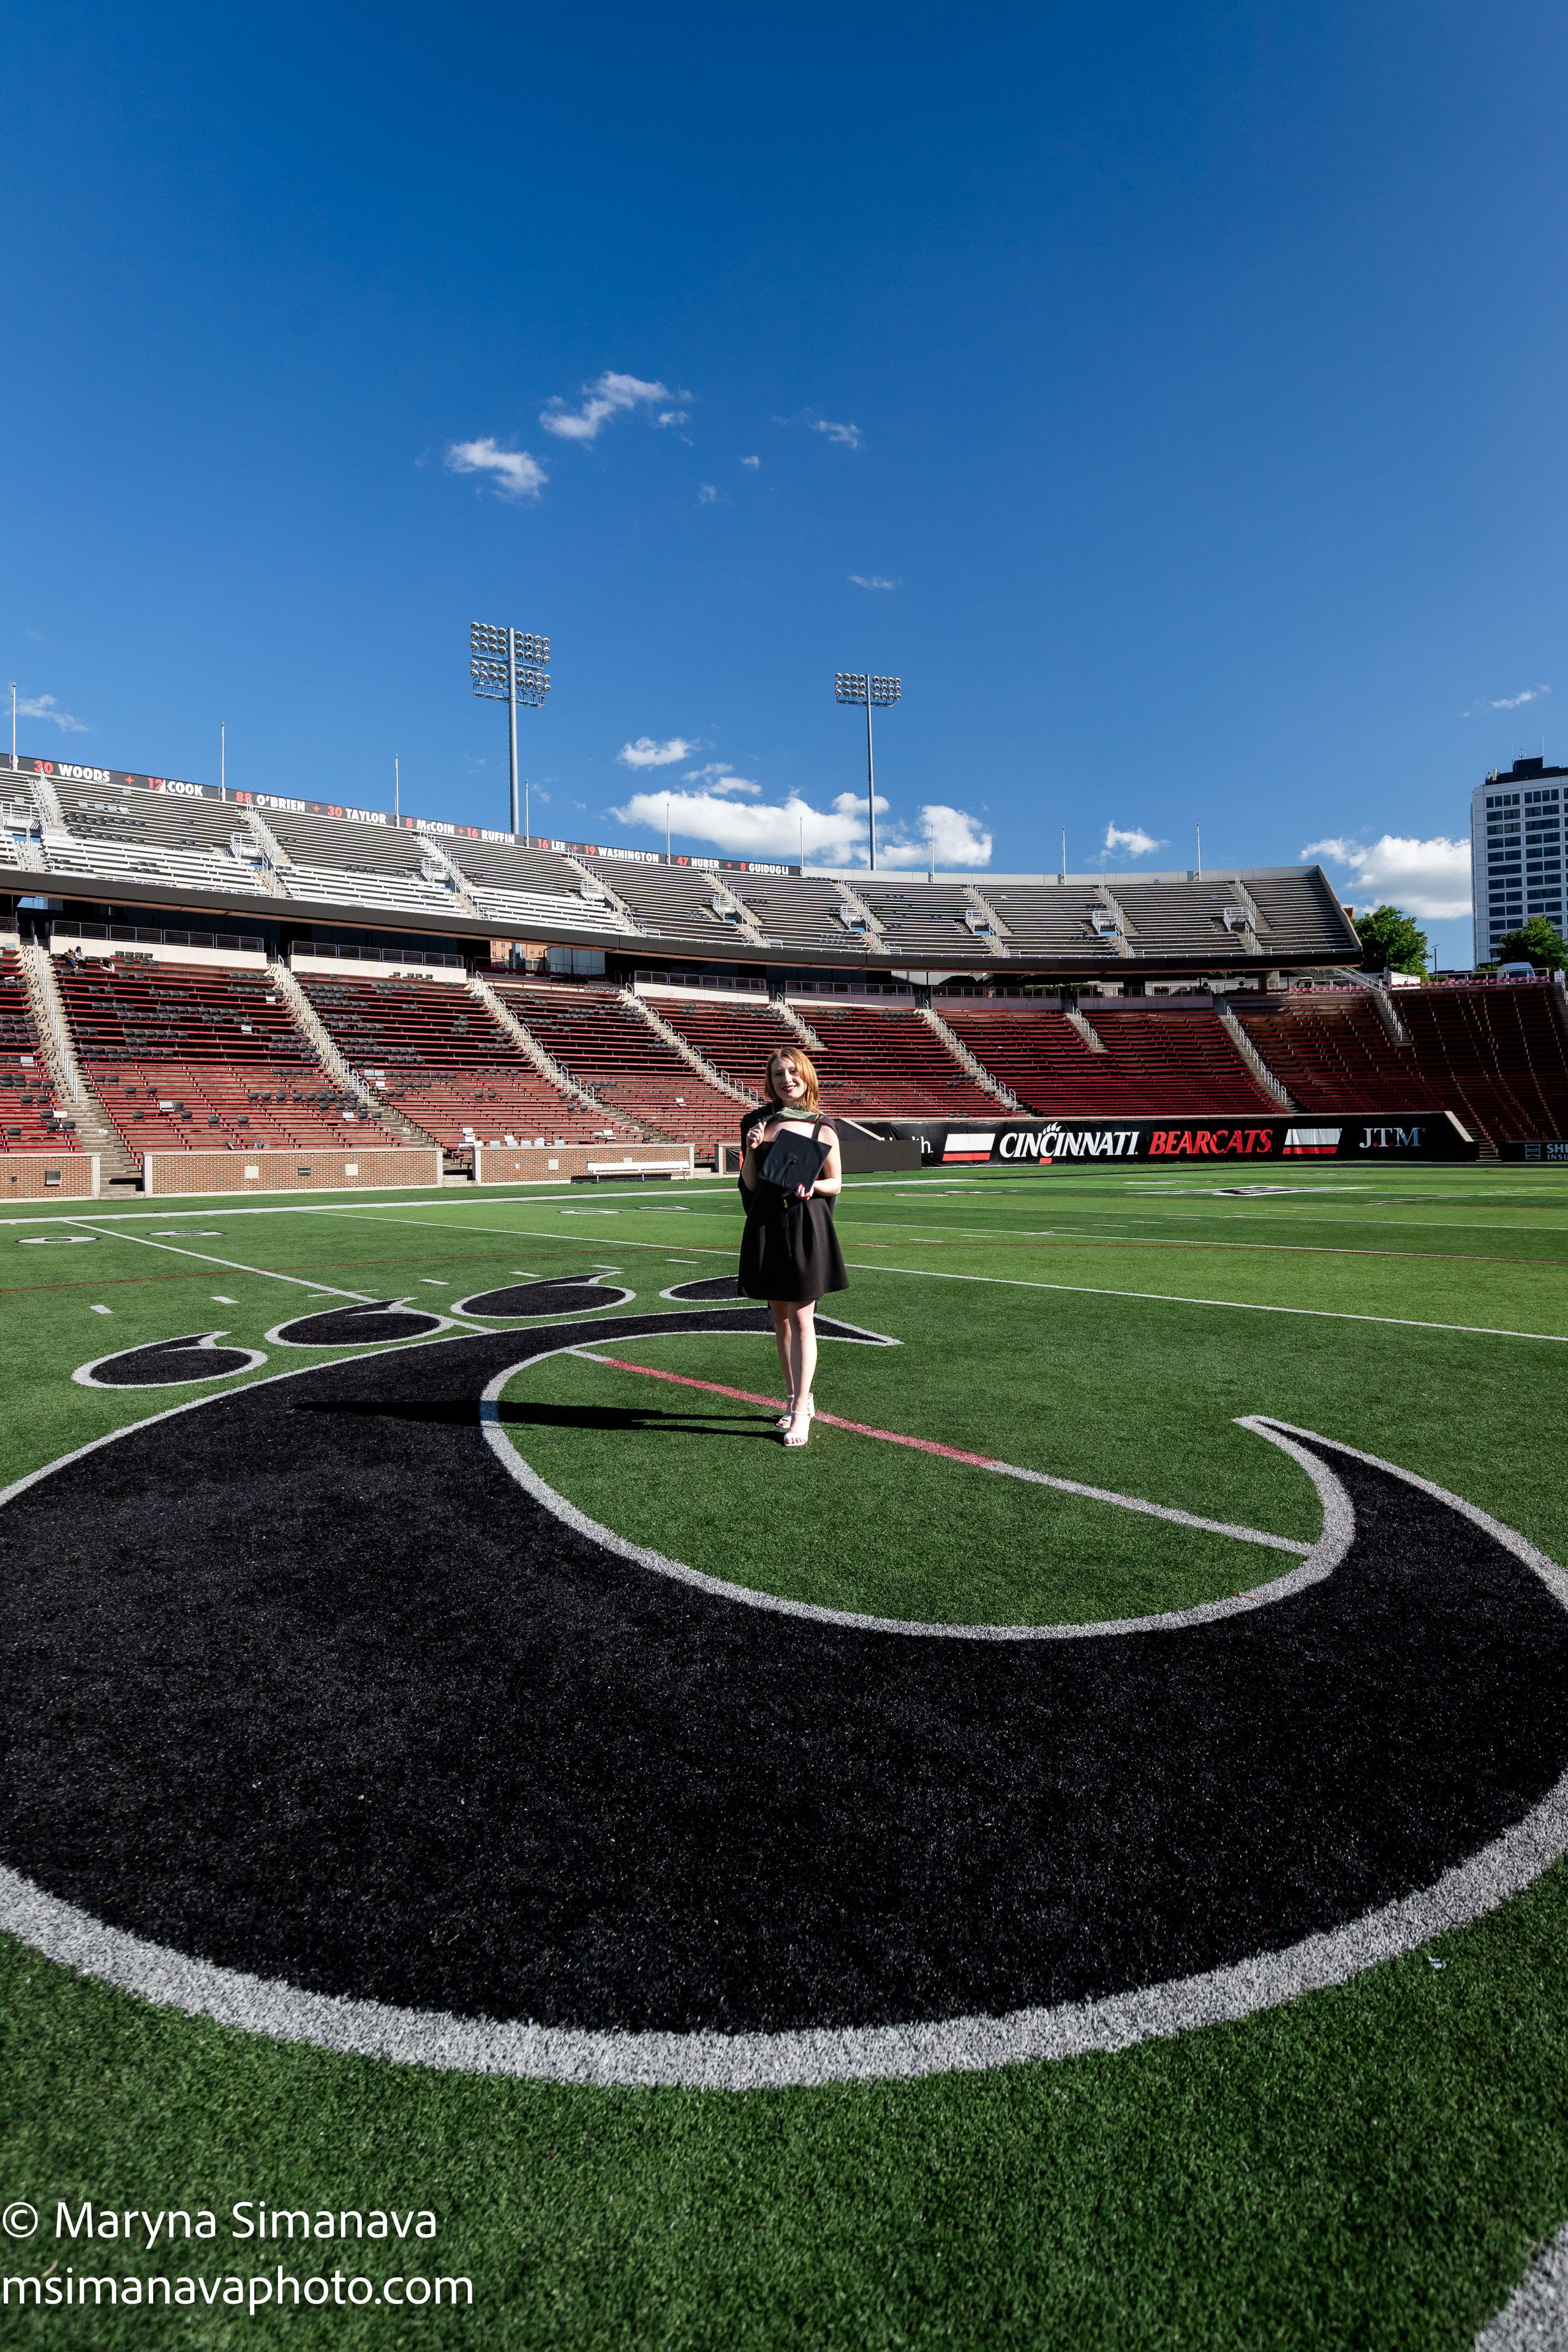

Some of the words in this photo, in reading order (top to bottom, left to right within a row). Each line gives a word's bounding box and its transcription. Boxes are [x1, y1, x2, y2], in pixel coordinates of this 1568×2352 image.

[34, 760, 54, 775] 30
[58, 764, 110, 782] WOODS
[148, 777, 164, 791] 12
[168, 781, 203, 796] COOK
[236, 791, 252, 804] 88
[257, 794, 306, 812] O'BRIEN
[328, 805, 342, 818] 30
[345, 808, 386, 824] TAYLOR
[405, 818, 413, 828] 8
[417, 819, 454, 835] McCOIN
[467, 827, 478, 839] 16
[481, 830, 515, 845] RUFFIN
[537, 839, 549, 850] 16
[551, 840, 566, 851] LEE
[584, 845, 595, 855] 19
[598, 846, 659, 863] WASHINGTON
[677, 856, 688, 867] 47
[691, 858, 720, 870] HUBER
[740, 862, 746, 872] 8
[748, 863, 789, 875] GUIDUGLI
[1000, 1131, 1139, 1158] CINCINNATI
[1148, 1129, 1273, 1155] BEARCATS
